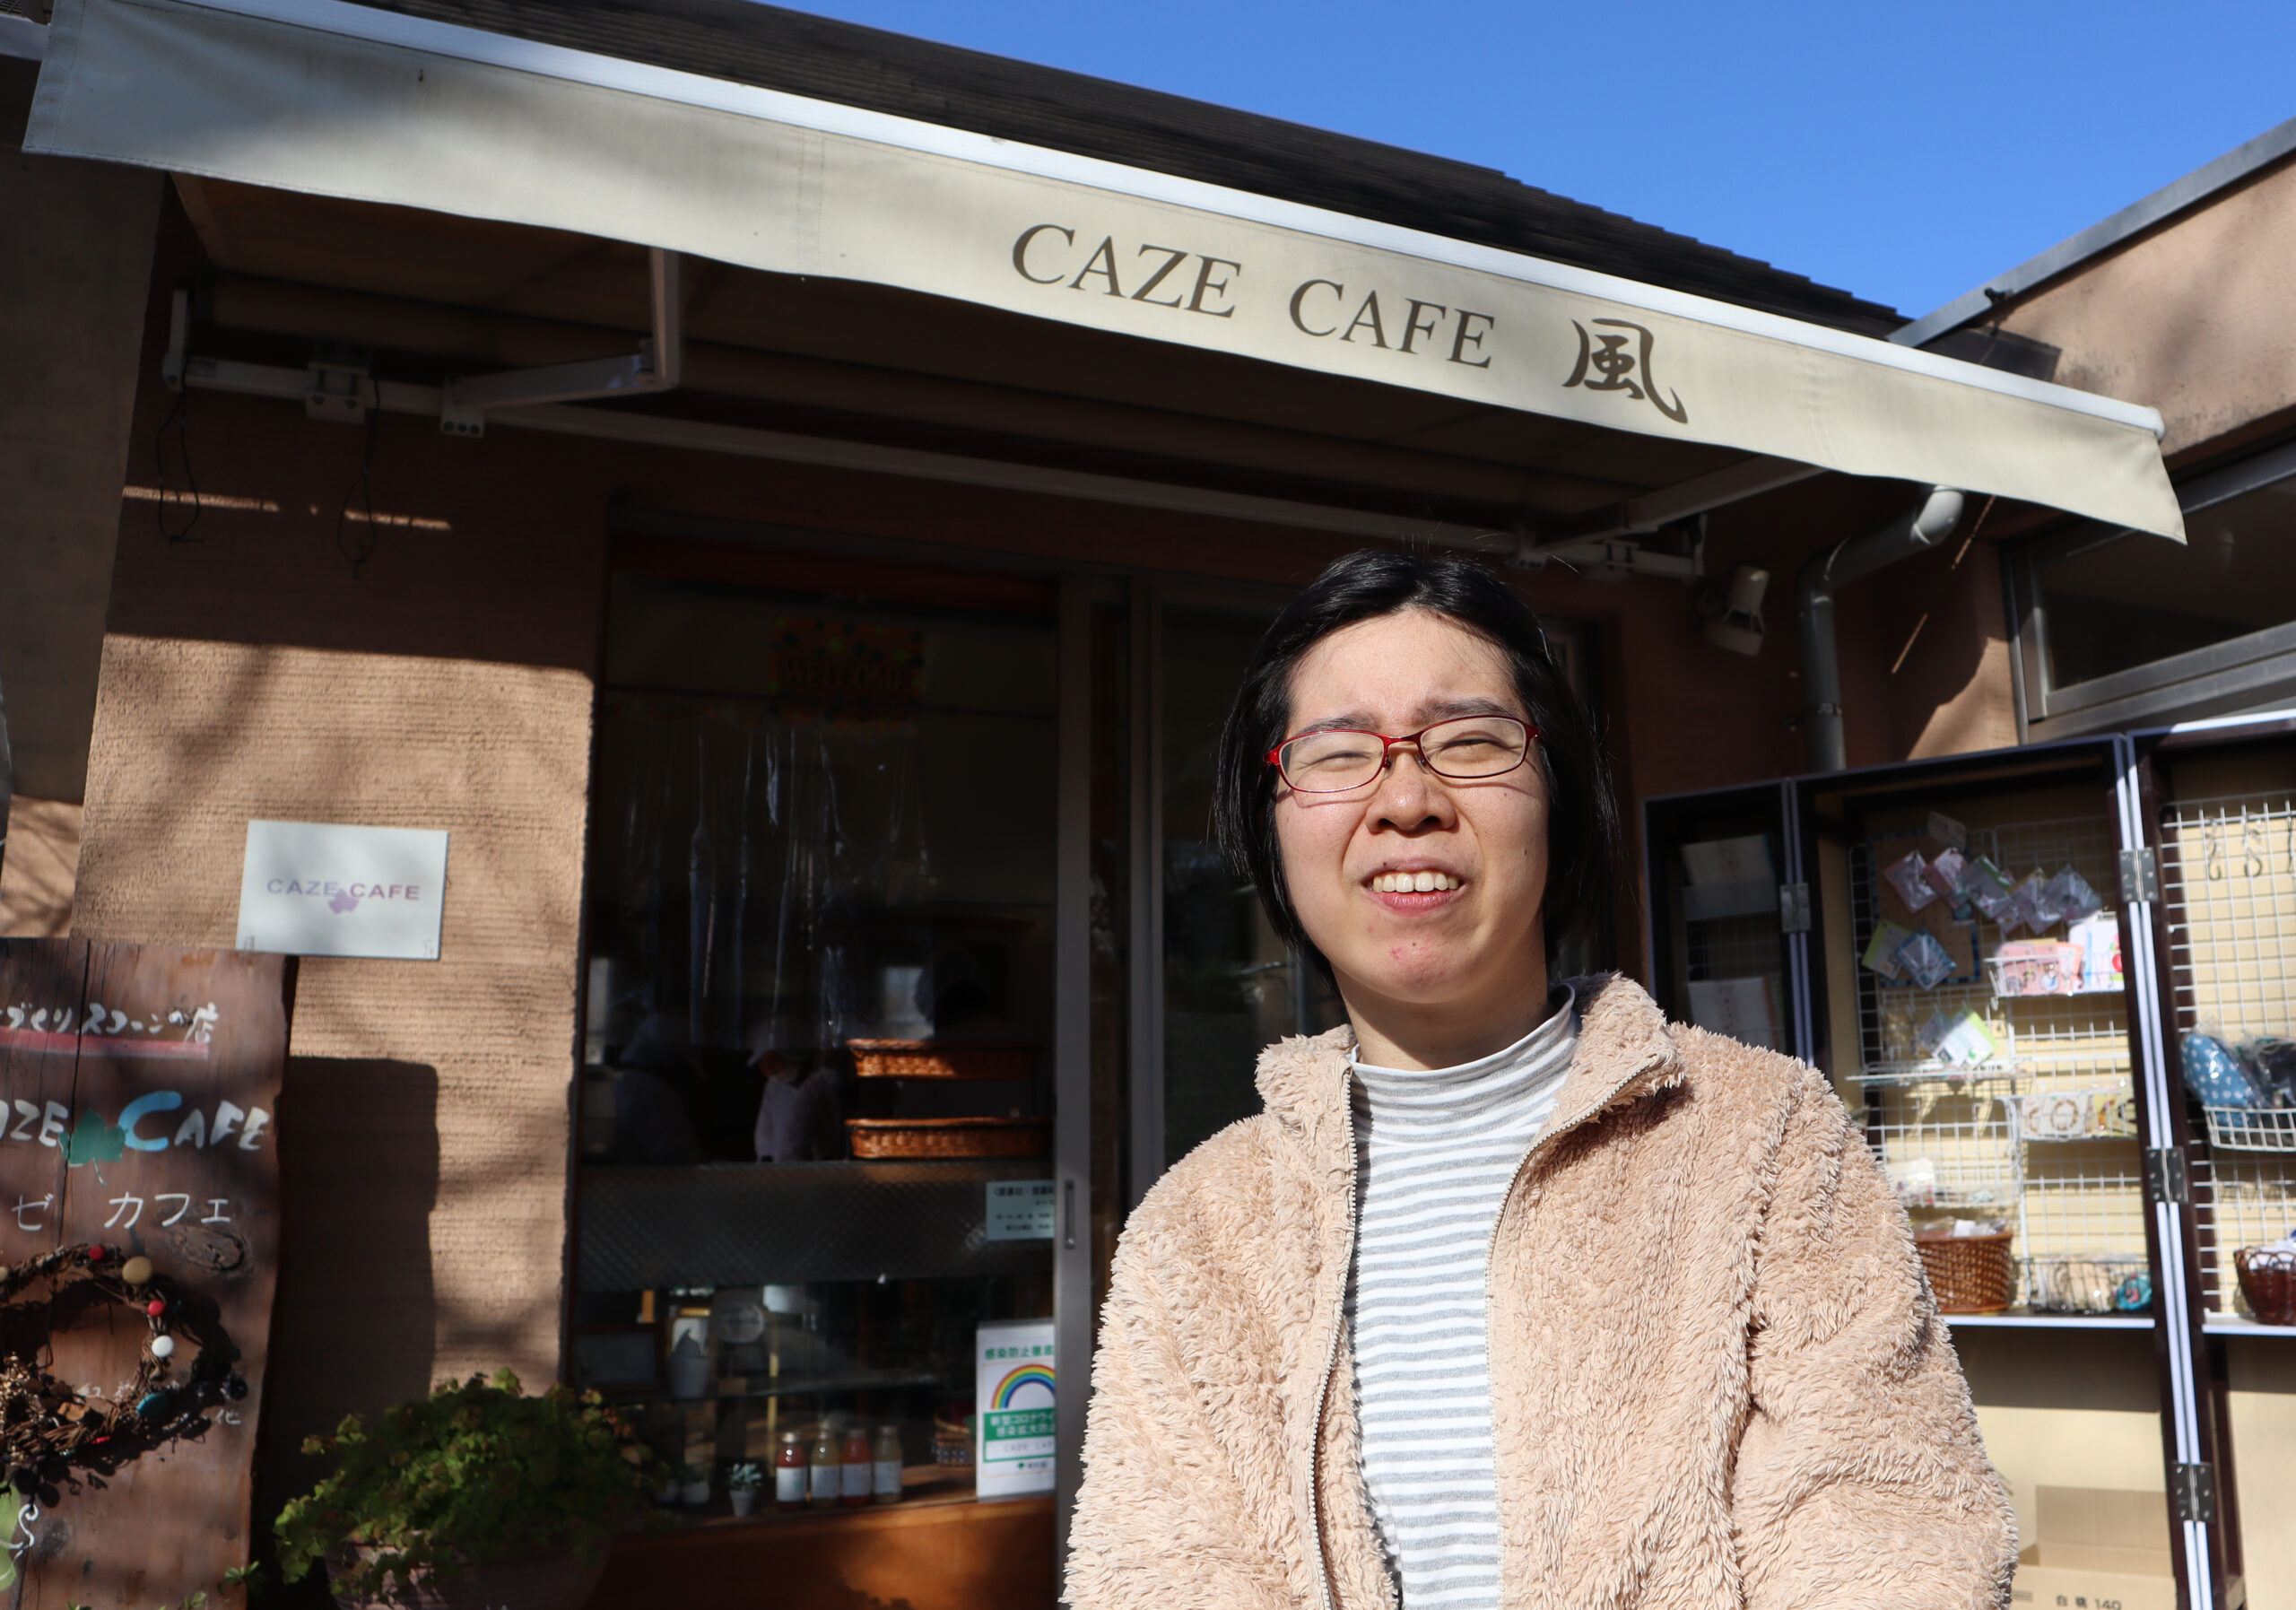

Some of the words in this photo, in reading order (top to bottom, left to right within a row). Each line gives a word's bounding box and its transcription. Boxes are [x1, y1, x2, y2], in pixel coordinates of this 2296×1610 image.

[1013, 223, 1242, 318] CAZE
[1290, 279, 1496, 369] CAFE
[1563, 318, 1688, 424] 風
[779, 659, 909, 692] WELCOME
[266, 878, 339, 897] CAZE
[350, 883, 421, 901] CAFE
[0, 1002, 220, 1044] づくりスコーンの店
[117, 1090, 270, 1152] CAFE
[104, 1191, 231, 1230] カフェ
